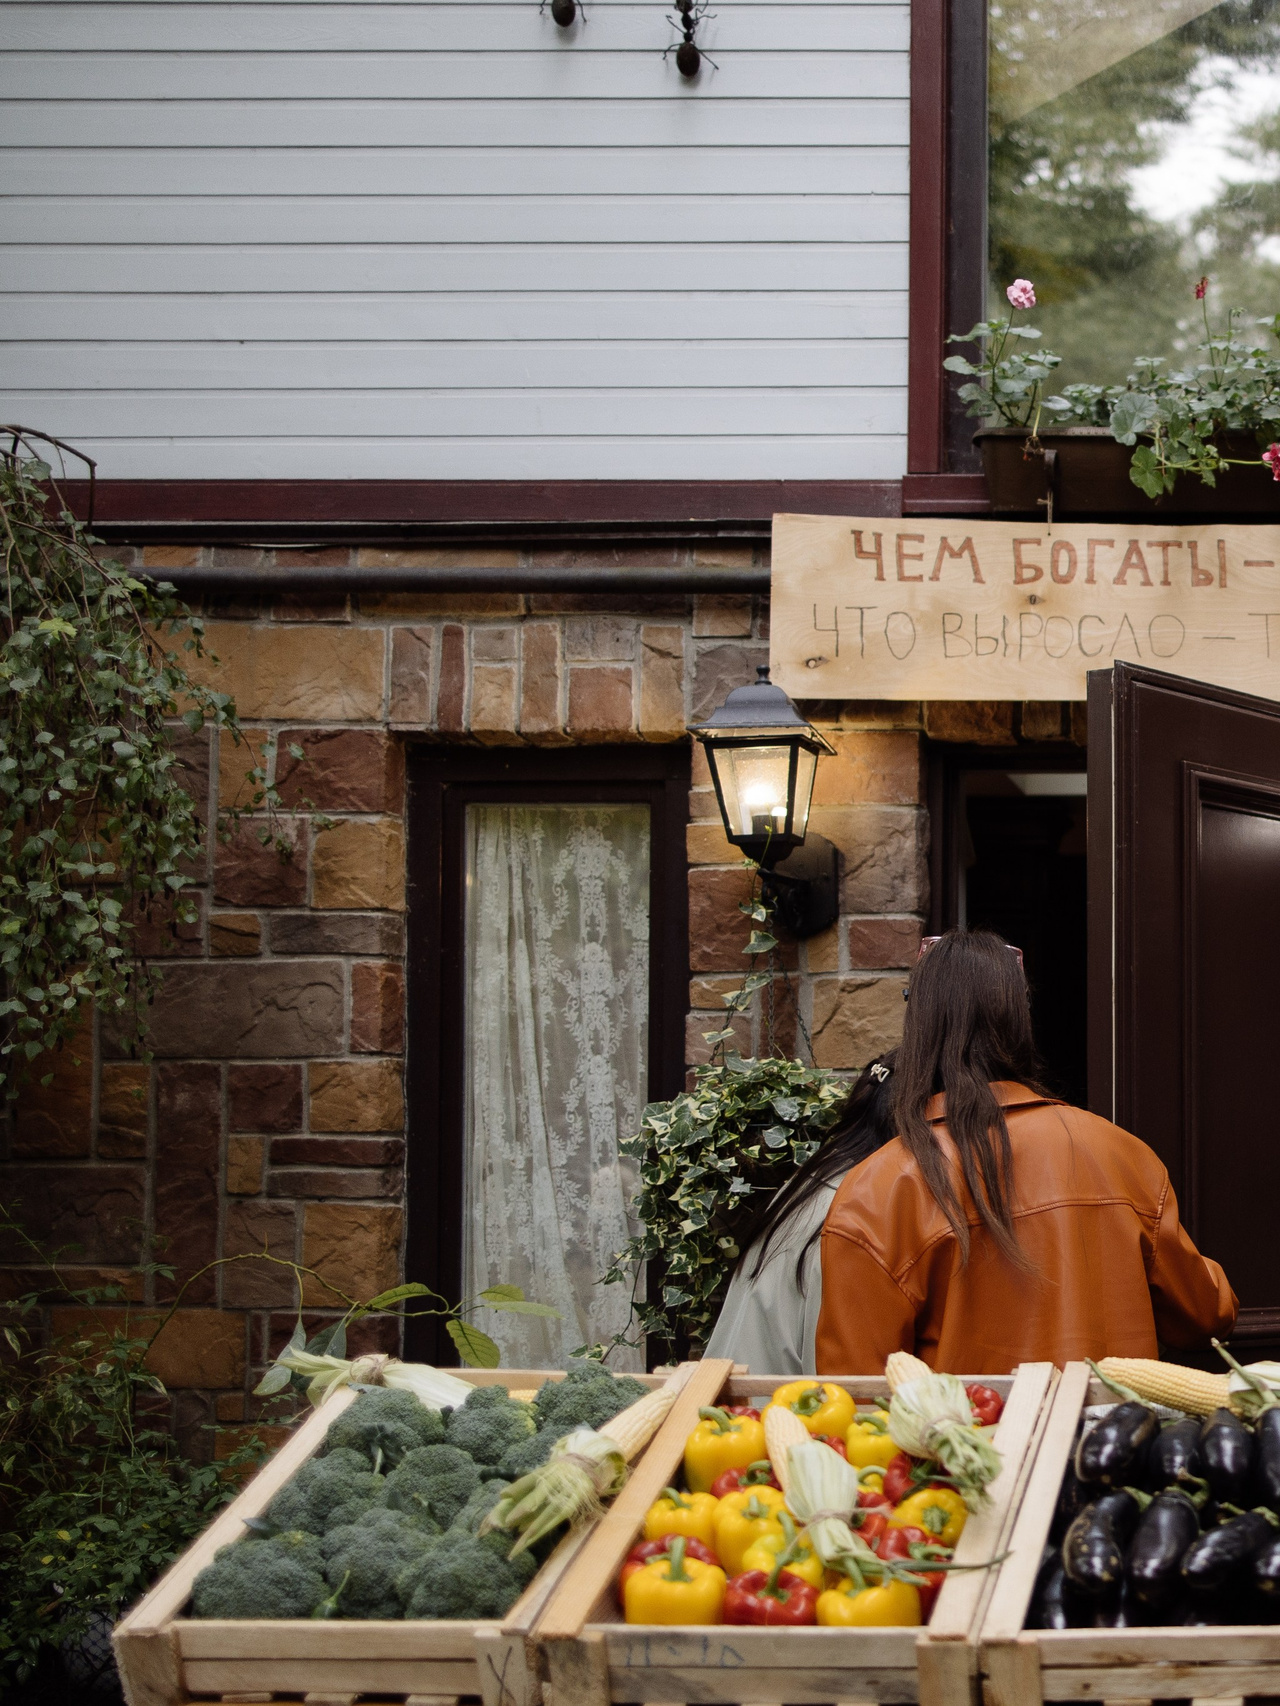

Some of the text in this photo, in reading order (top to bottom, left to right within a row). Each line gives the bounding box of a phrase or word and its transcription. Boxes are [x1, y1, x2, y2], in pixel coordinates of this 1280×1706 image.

[850, 529, 986, 584] ЧЕМ
[1012, 537, 1227, 588] БОГАТЫ
[813, 603, 917, 661] ЧТО
[942, 610, 1186, 662] ВЫРОСЛО
